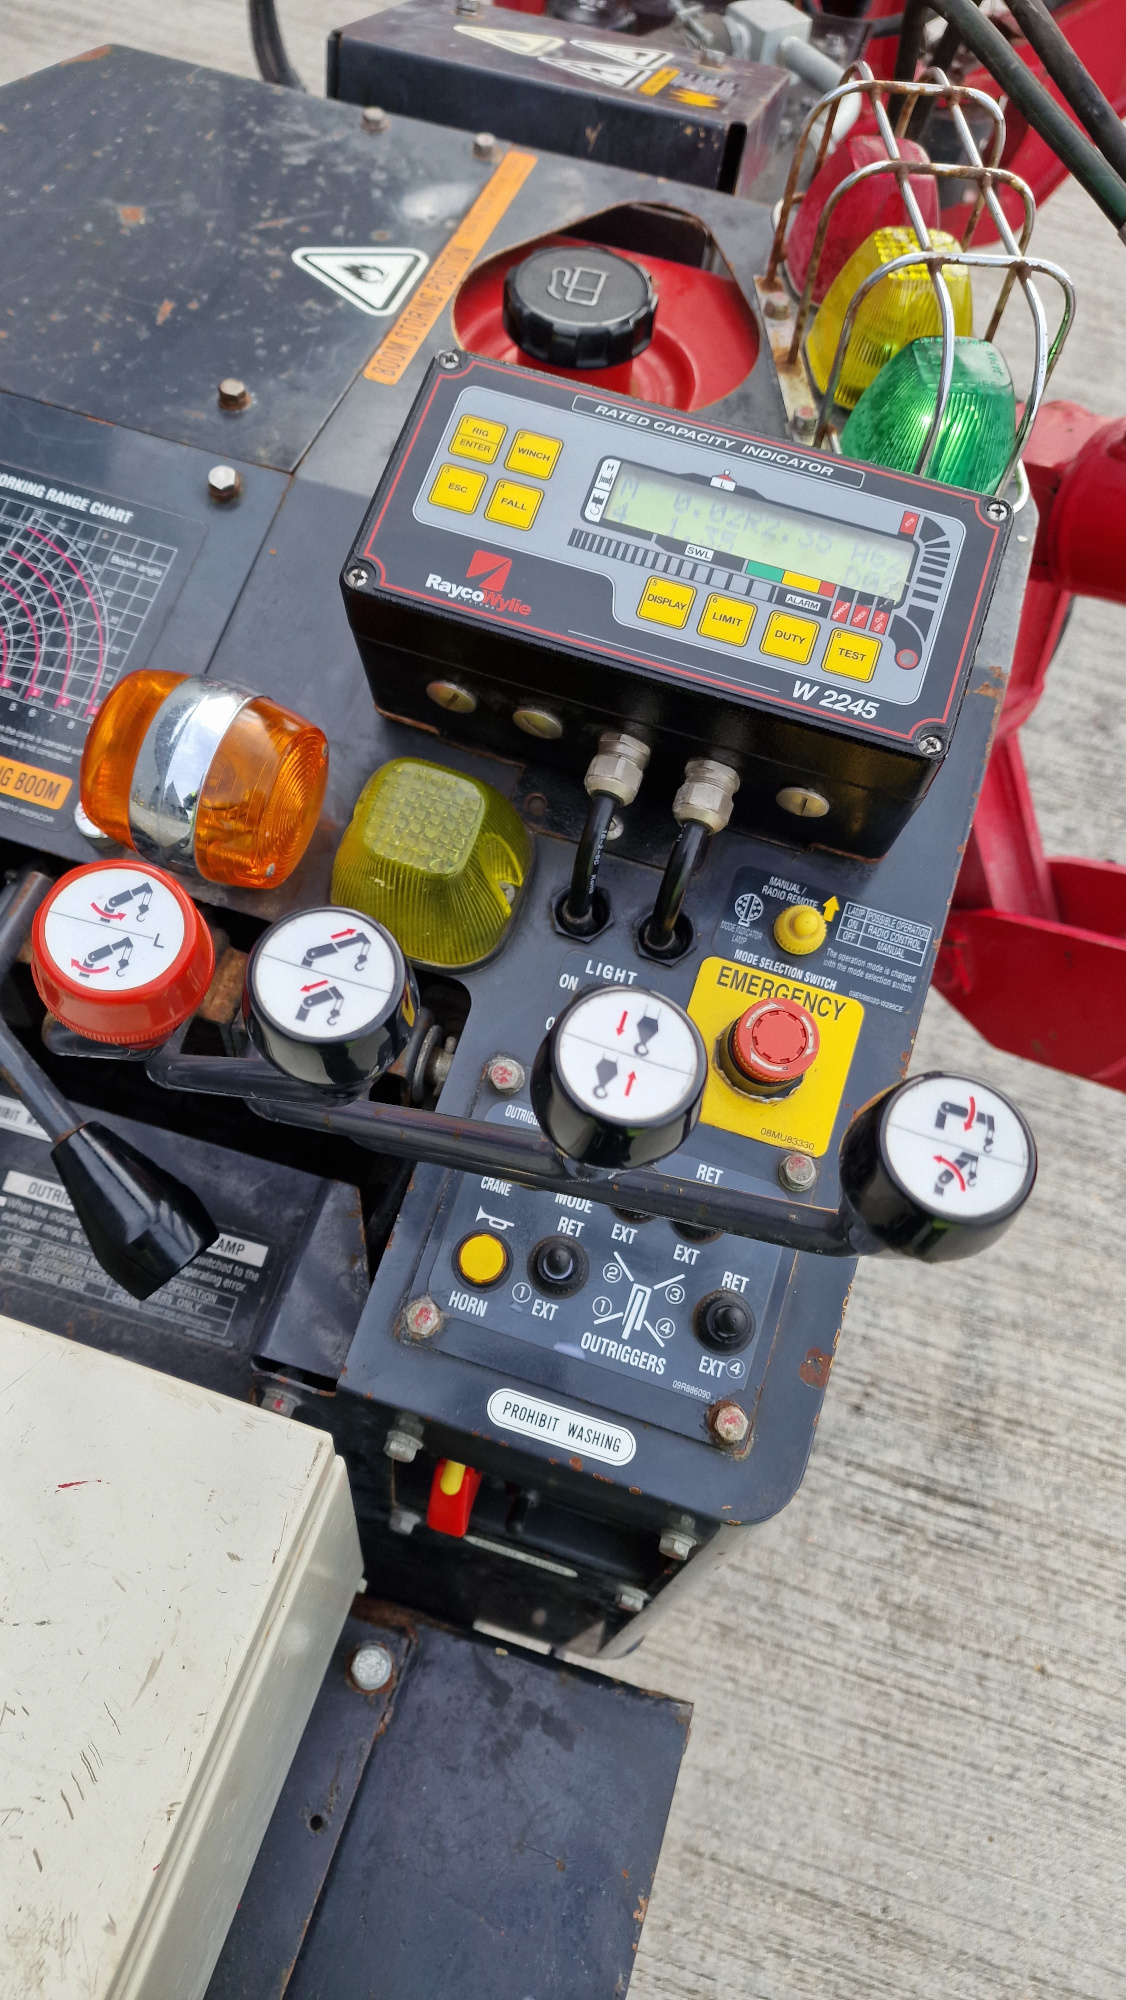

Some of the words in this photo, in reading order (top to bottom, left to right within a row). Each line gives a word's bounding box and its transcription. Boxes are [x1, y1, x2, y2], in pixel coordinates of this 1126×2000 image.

[372, 339, 409, 376] BOOM
[473, 428, 488, 437] RIG
[595, 405, 650, 427] RATED
[653, 421, 736, 448] CAPACITY
[741, 445, 834, 477] INDICATOR
[459, 439, 491, 453] ENTER
[518, 447, 550, 462] WINCH
[0, 472, 46, 499] ORKING
[45, 487, 91, 512] RANGE
[89, 501, 134, 524] CHART
[448, 482, 467, 494] ESC
[501, 498, 527, 511] FALL
[687, 547, 712, 560] SWL
[646, 592, 687, 612] DISPLAY
[786, 596, 819, 611] ALARM
[712, 611, 743, 627] LIMIT
[774, 629, 807, 645] DUTY
[838, 647, 867, 662] TEST
[792, 680, 820, 701] W
[819, 689, 881, 720] 2245
[48, 713, 57, 723] 7
[14, 771, 61, 802] BOOM
[761, 885, 786, 900] RADIO
[768, 876, 801, 894] MANUAL
[720, 920, 736, 932] MODE
[734, 924, 763, 941] INDICATOR
[847, 905, 866, 918] LAMP
[867, 911, 897, 929] POSSIBLE
[896, 920, 930, 939] OPERATION
[731, 934, 747, 945] LAMP
[842, 931, 856, 942] OFF
[876, 941, 905, 958] MANUAL
[847, 919, 859, 930] ON
[867, 925, 889, 940] RADIO
[889, 932, 921, 950] CONTROL
[585, 959, 638, 985] LIGHT
[733, 949, 758, 968] MODE
[758, 955, 802, 979] SELECTION
[803, 968, 838, 991] SWITCH
[823, 959, 836, 969] with
[836, 962, 847, 973] the
[846, 966, 864, 978] mode
[864, 971, 891, 986] selection
[891, 980, 914, 994] switch.
[826, 947, 837, 958] The
[837, 952, 866, 968] operation
[866, 961, 883, 973] mode
[883, 966, 890, 975] is
[890, 968, 917, 984] changed
[559, 973, 579, 991] ON
[716, 965, 847, 1021] EMERGENCY
[545, 1016, 556, 1031] O
[760, 1126, 815, 1151] 08MU83330
[696, 1163, 724, 1186] RET
[480, 1176, 513, 1197] CRANE
[32, 1205, 49, 1219] the
[554, 1193, 593, 1214] MODE
[557, 1216, 585, 1238] RET
[611, 1223, 638, 1245] EXT
[673, 1244, 700, 1266] EXT
[233, 1266, 244, 1277] to
[244, 1269, 260, 1282] the
[721, 1271, 749, 1293] RET
[448, 1290, 488, 1317] HORN
[531, 1299, 559, 1321] EXT
[580, 1331, 667, 1375] OUTRIGGERS
[698, 1356, 726, 1378] EXT
[671, 1379, 712, 1400] 09R886090
[502, 1401, 560, 1432] PROHIBIT
[567, 1424, 622, 1453] WASHING
